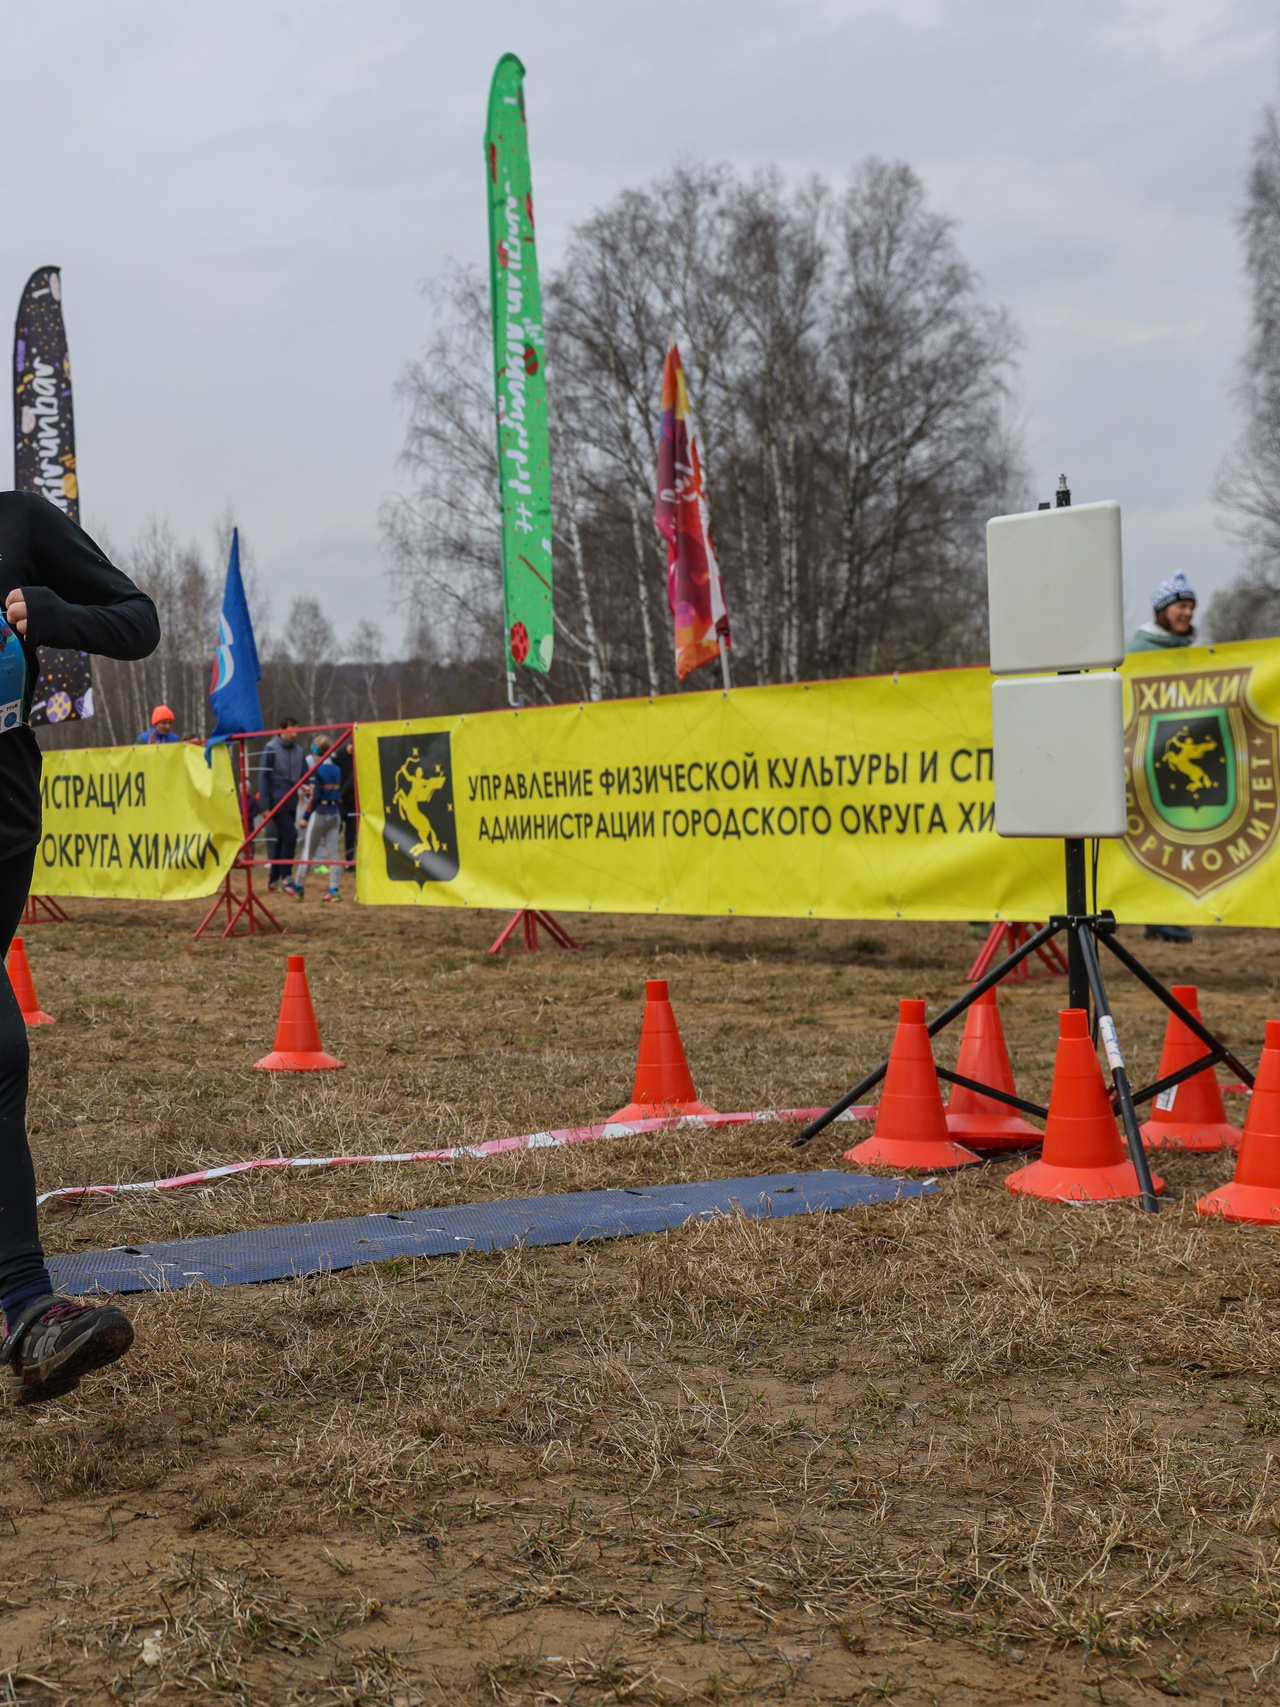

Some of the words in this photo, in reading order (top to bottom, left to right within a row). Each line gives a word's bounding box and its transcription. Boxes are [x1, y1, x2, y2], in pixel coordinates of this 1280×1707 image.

[1139, 674, 1241, 711] ХИМКИ
[468, 769, 593, 802] УПРАВЛЕНИЕ
[599, 752, 759, 796] ФИЗИЧЕСКОЙ
[768, 752, 908, 789] КУЛЬТУРЫ
[920, 750, 938, 784] И
[478, 810, 655, 844] АДМИНИСТРАЦИИ
[662, 805, 832, 840] ГОРОДСКОГО
[840, 802, 947, 835] ОКРУГА
[42, 833, 122, 868] ОКРУГА
[128, 832, 220, 870] ХИМКИ
